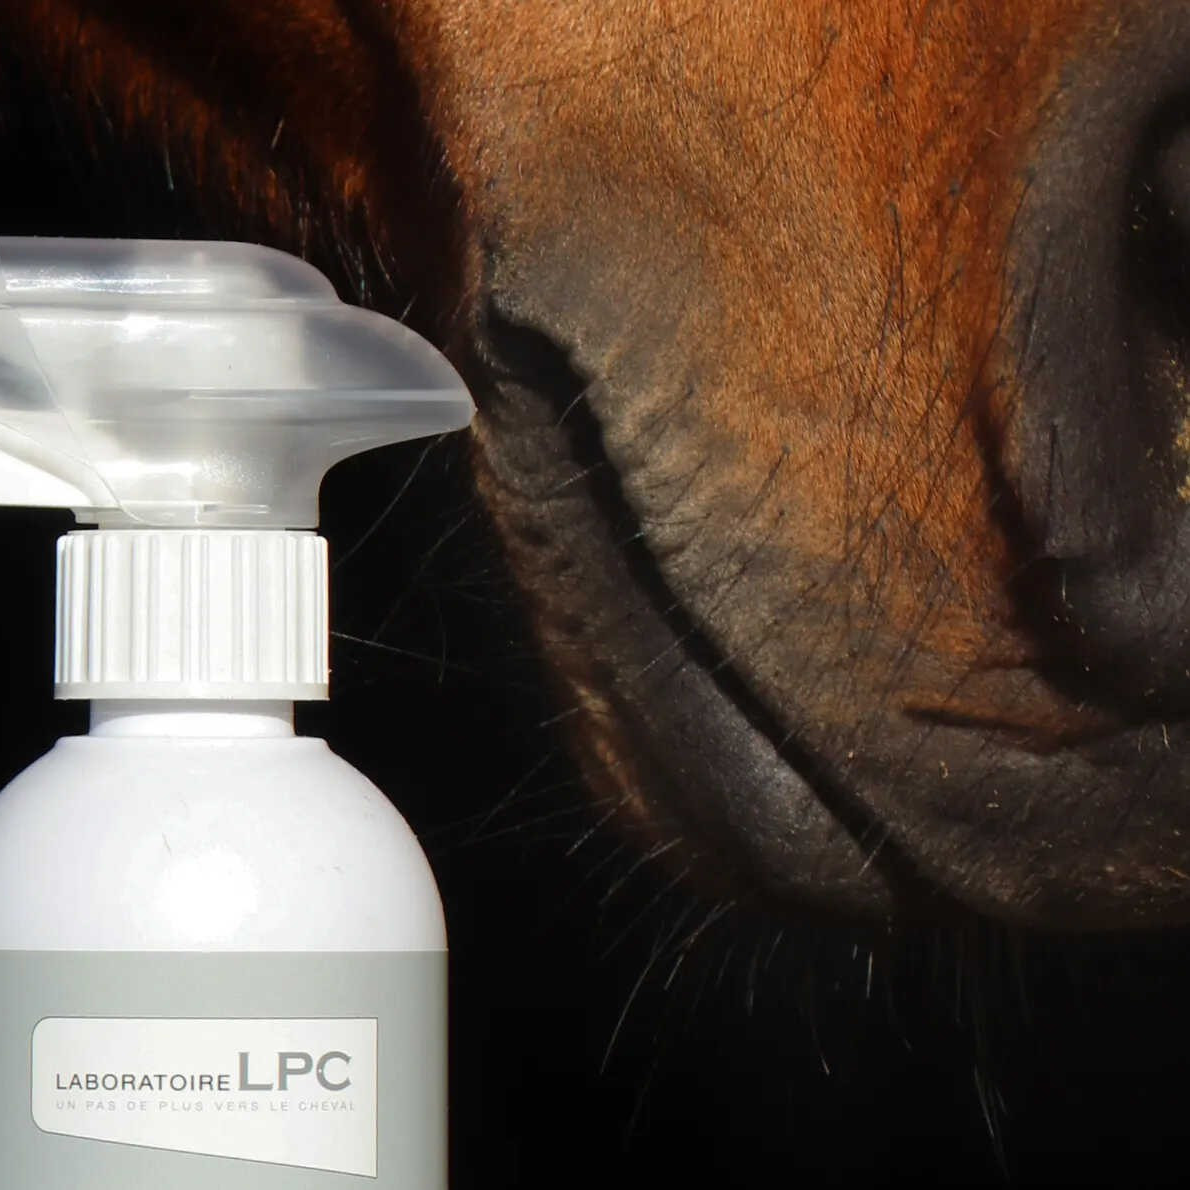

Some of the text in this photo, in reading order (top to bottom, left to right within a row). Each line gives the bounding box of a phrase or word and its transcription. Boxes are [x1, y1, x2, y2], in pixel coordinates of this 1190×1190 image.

[55, 1050, 353, 1093] LABORATOIRE LPC
[55, 1100, 355, 1112] UN PAS DE PLUS VERS LE CHEVAL
